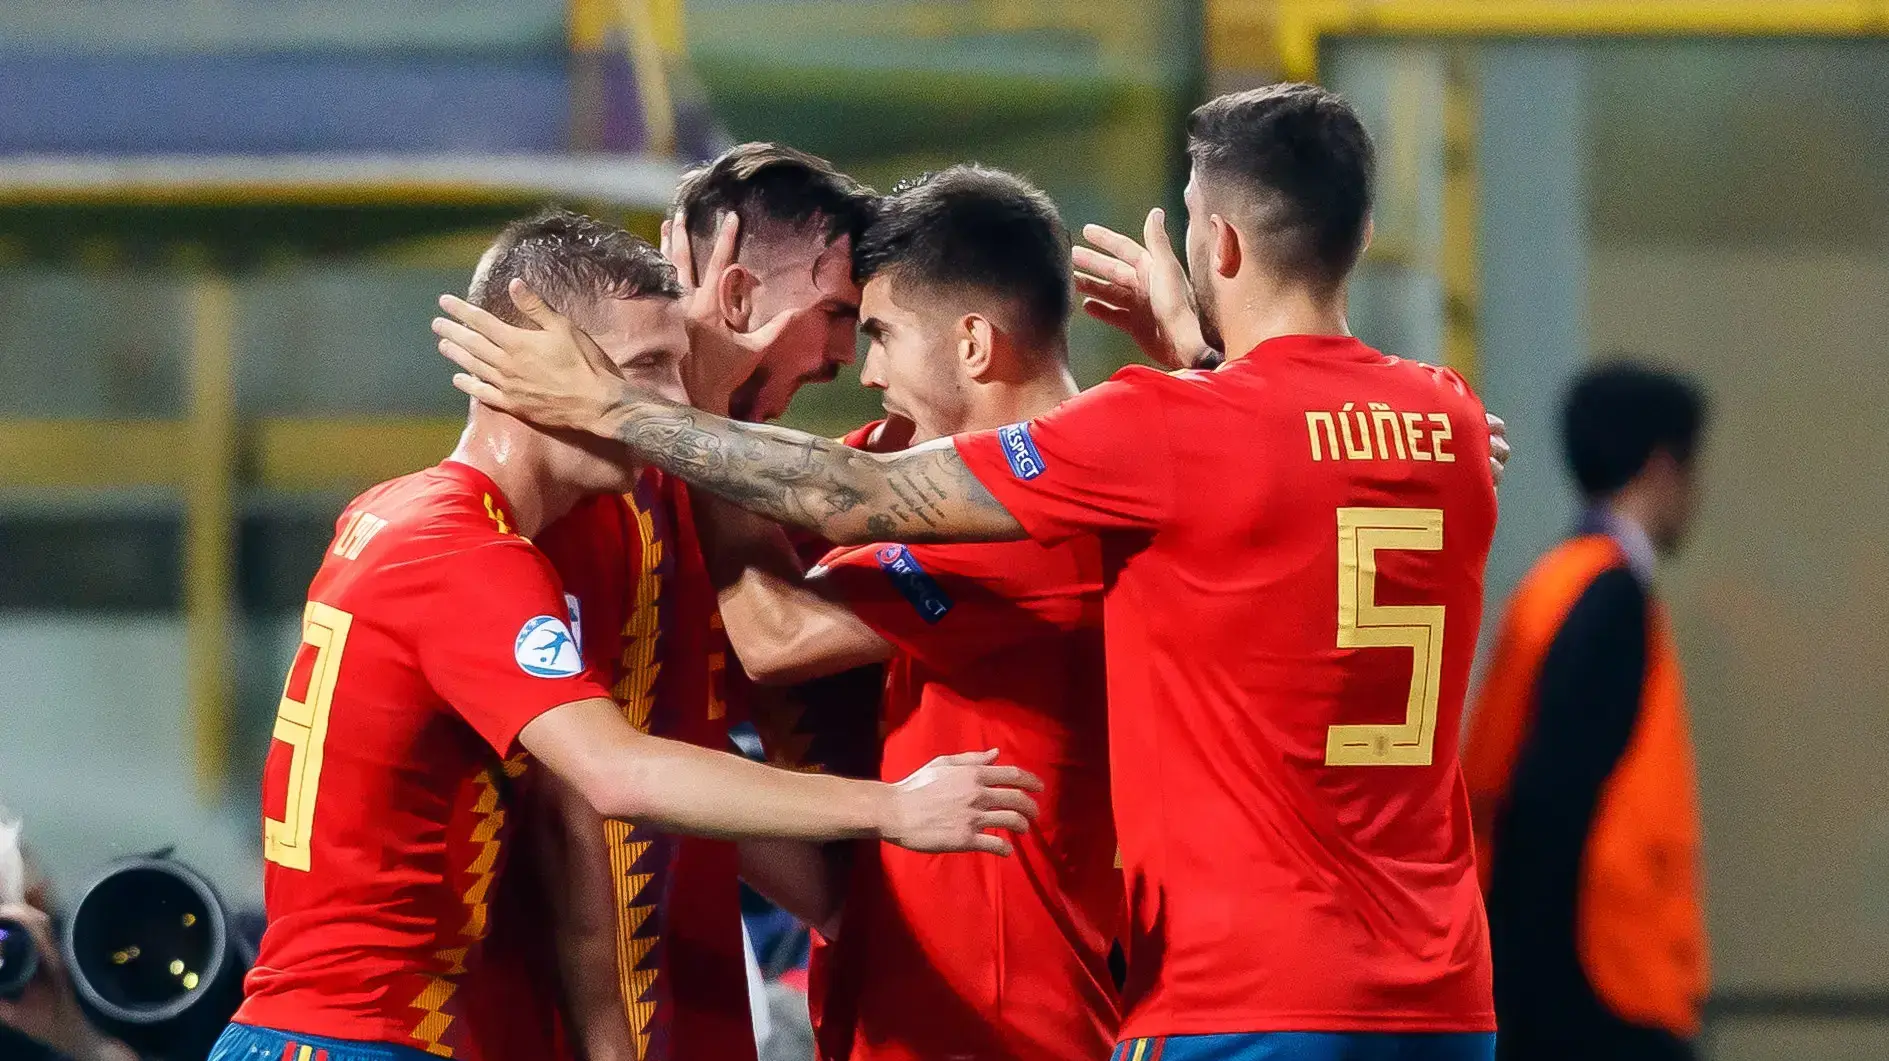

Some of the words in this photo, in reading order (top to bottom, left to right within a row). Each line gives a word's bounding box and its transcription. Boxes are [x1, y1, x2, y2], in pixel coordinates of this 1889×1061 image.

[1006, 425, 1040, 478] ESPECT
[1305, 402, 1456, 462] NÚÑEZ
[1324, 507, 1446, 766] 5
[264, 601, 353, 872] 9
